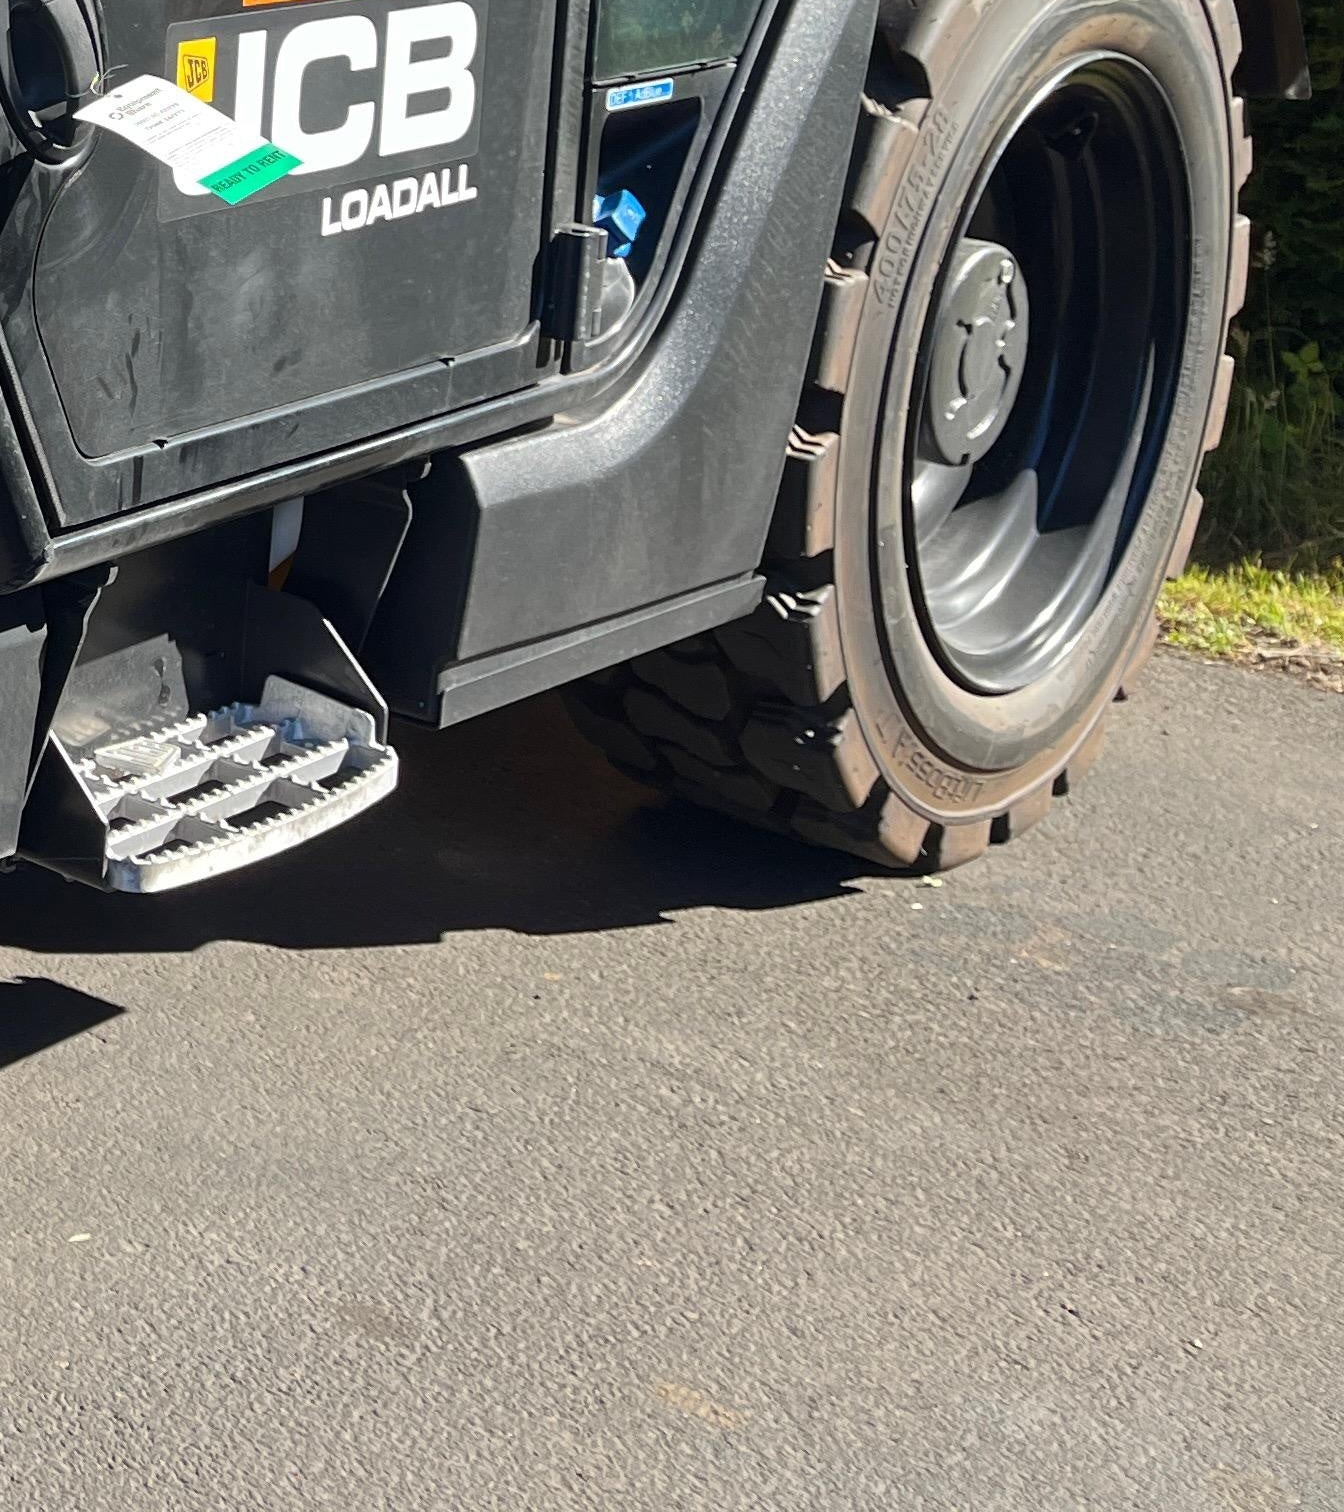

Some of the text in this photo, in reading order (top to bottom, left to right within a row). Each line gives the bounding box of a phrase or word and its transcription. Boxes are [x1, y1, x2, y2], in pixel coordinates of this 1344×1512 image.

[173, 1, 478, 197] JCB
[186, 56, 209, 89] JCB
[211, 149, 287, 193] READY TO RENT
[321, 164, 478, 236] LOADALL
